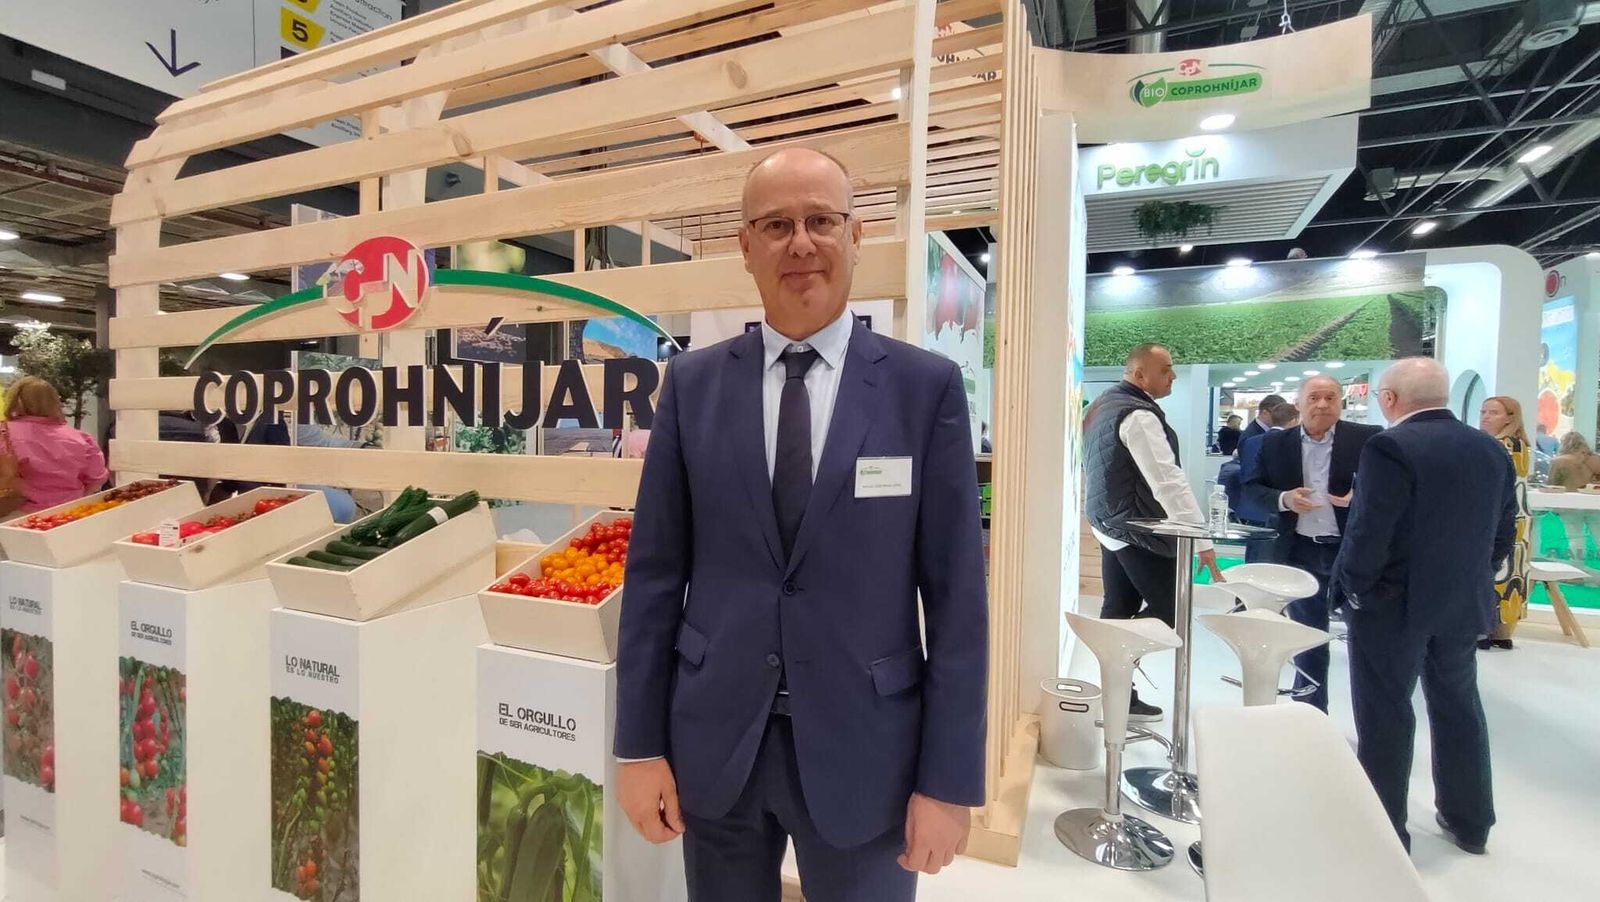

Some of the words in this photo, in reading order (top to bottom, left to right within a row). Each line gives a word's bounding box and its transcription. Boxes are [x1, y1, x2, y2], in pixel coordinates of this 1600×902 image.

[292, 18, 309, 43] 5
[1144, 87, 1165, 98] BIO
[1171, 77, 1257, 96] COPROHNÍJAR
[1097, 147, 1220, 190] Peregrin
[193, 317, 662, 430] COPROHNÍJAR
[131, 620, 140, 631] EL
[140, 623, 173, 638] ORGULLO
[285, 654, 298, 668] LO
[299, 657, 341, 678] NATURAL
[499, 702, 513, 718] EL
[517, 707, 577, 732] ORGULLO
[499, 717, 508, 726] DE
[509, 719, 522, 730] SER
[523, 723, 576, 742] AGRICULTORES
